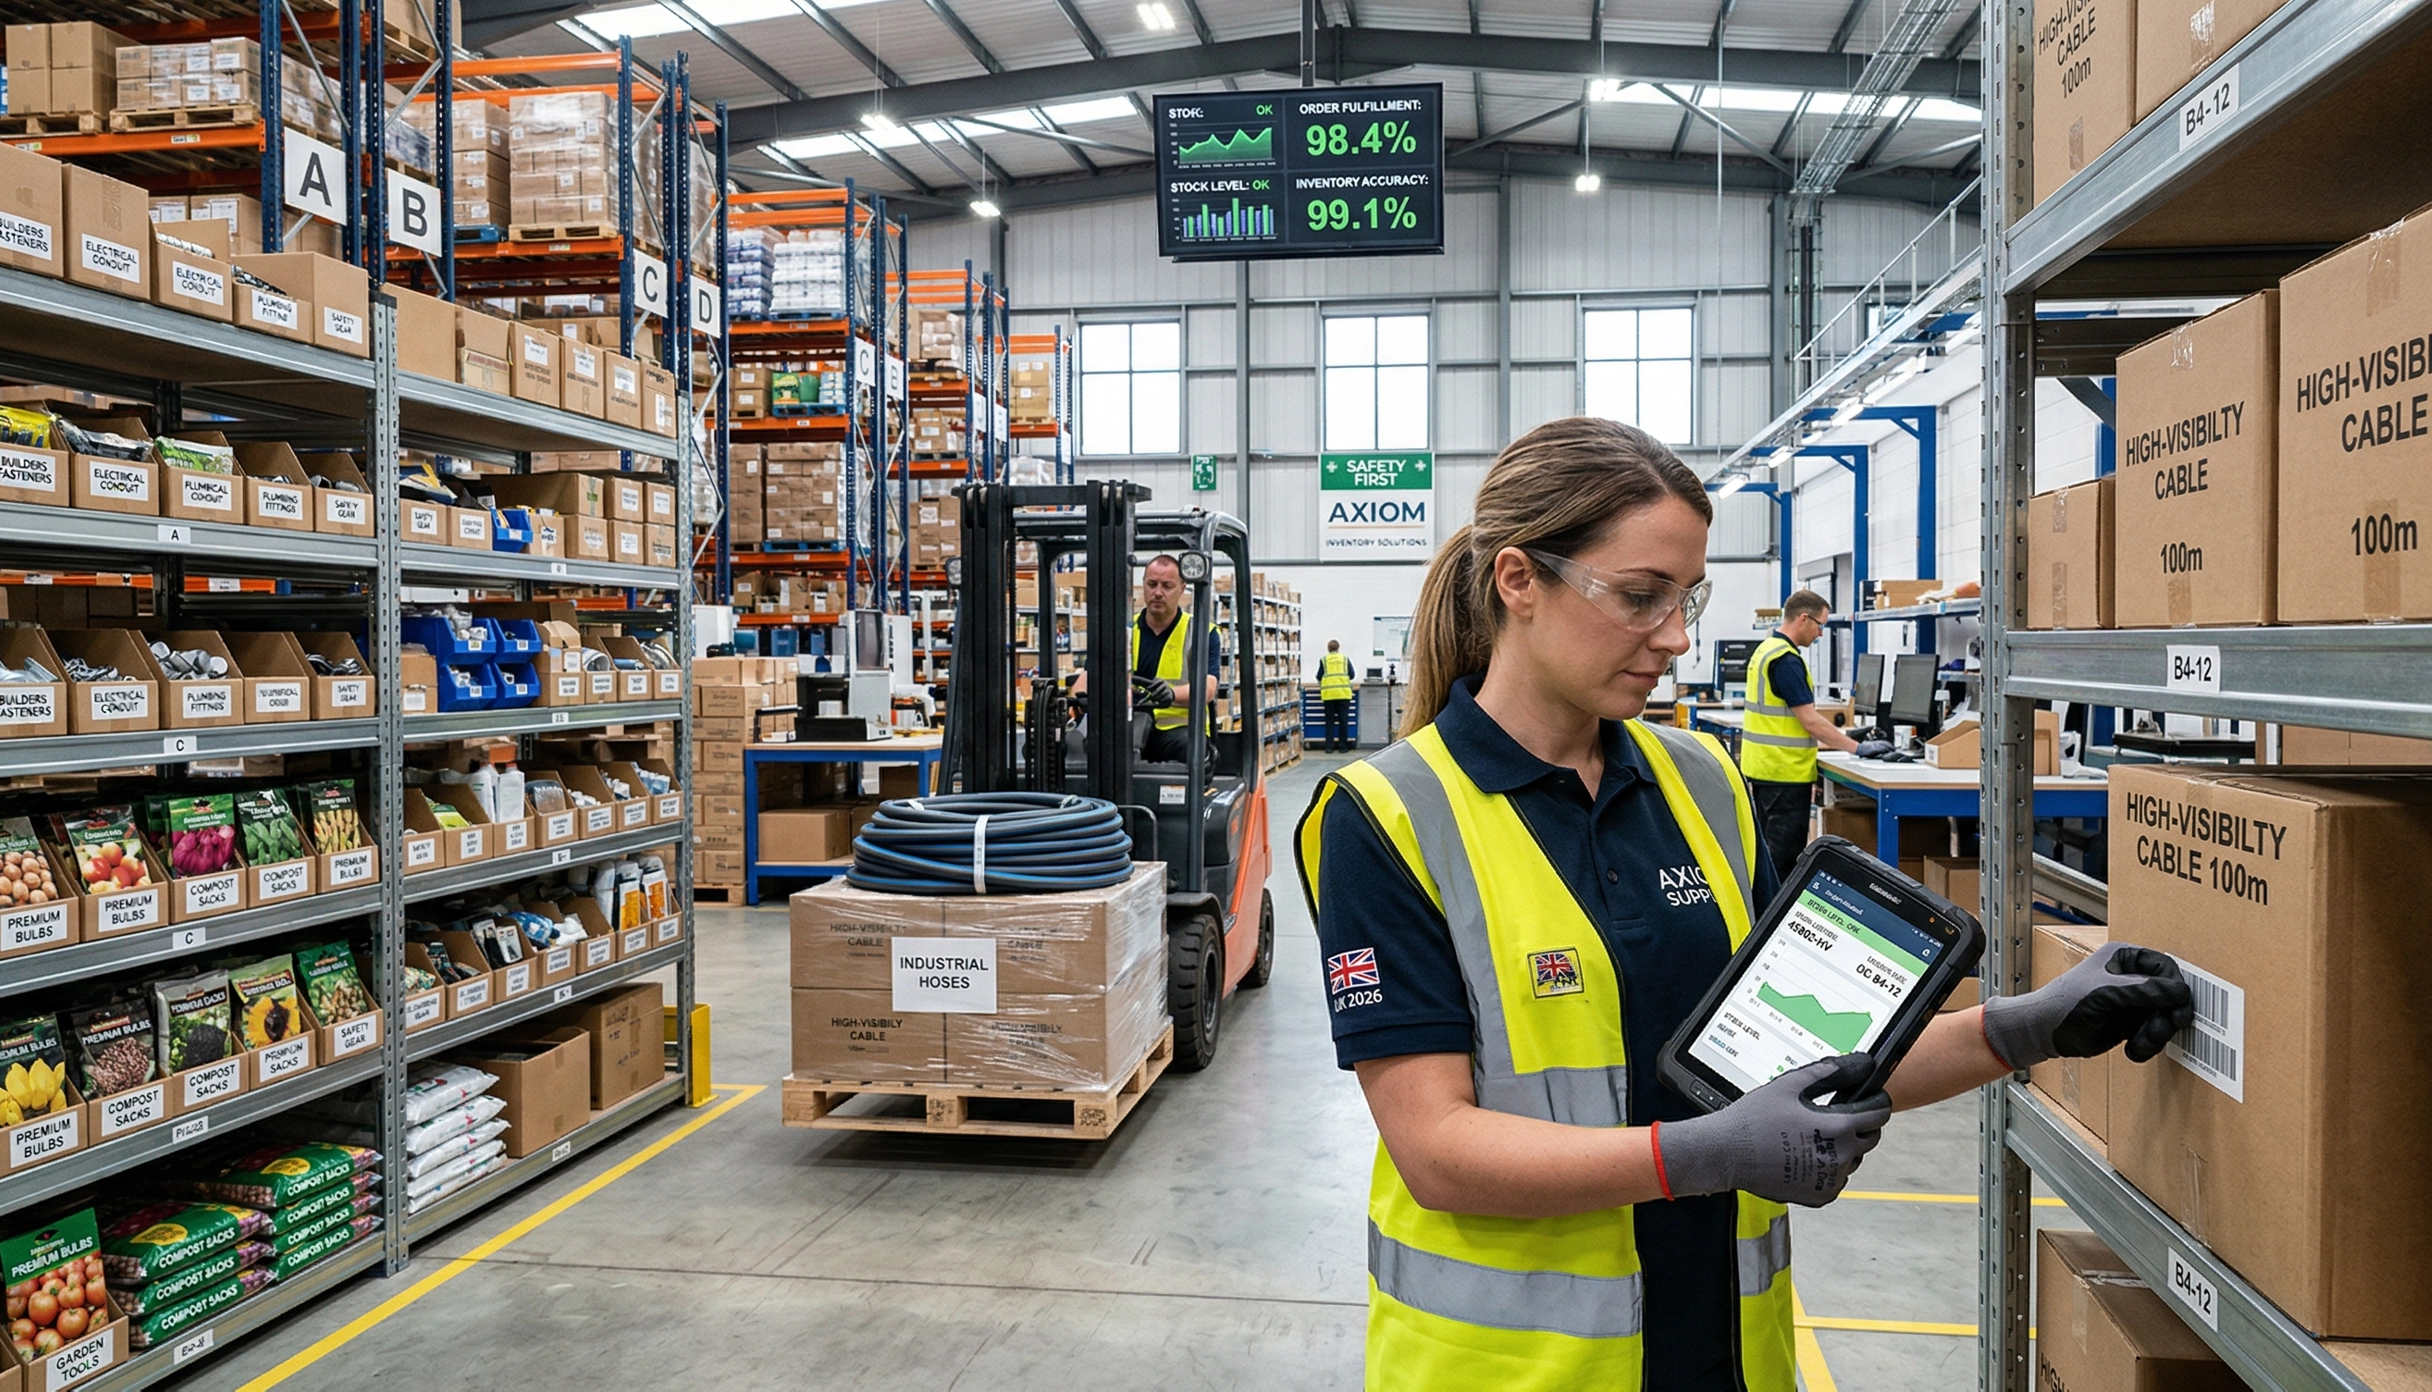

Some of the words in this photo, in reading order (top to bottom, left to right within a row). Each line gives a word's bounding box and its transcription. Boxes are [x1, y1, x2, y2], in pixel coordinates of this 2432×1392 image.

[2057, 6, 2096, 66] CABLE
[2061, 57, 2092, 99] 100m
[1256, 104, 1273, 116] OK
[1299, 101, 1340, 115] ORDER
[1342, 99, 1422, 113] FULFILLMENT:
[2186, 82, 2230, 137] B4-12
[1306, 120, 1417, 156] 98.4%
[299, 151, 332, 207] A
[1170, 180, 1209, 193] STOCK
[1211, 179, 1249, 192] LEVEL:
[1252, 179, 1270, 191] OK
[1296, 175, 1360, 189] INVENTORY
[1362, 174, 1429, 187] ACCURACY:
[402, 187, 428, 237] B
[1307, 196, 1417, 231] 99.1%
[642, 264, 658, 303] C
[698, 288, 712, 324] D
[860, 349, 869, 376] C
[2126, 400, 2244, 467] HIGH-VISIBILTY
[2341, 393, 2428, 452] CABLE
[1346, 459, 1407, 473] SAFETY
[1354, 473, 1398, 486] FIRST
[2154, 458, 2208, 500] CABLE
[1328, 501, 1426, 523] AXIOM
[171, 529, 179, 541] A
[1325, 538, 1375, 547] INVENTORY
[1378, 538, 1427, 547] SOLUTIONS
[2351, 513, 2418, 556] 100m
[2160, 541, 2203, 574] 100m
[2174, 655, 2212, 682] B4-12
[176, 740, 185, 752] C
[2126, 791, 2287, 860] HIGH-VISIBILTY
[2136, 835, 2202, 884] CABLE
[2209, 857, 2268, 906] 100m
[190, 878, 235, 895] COMPOST
[105, 895, 152, 912] PREMIUM
[8, 910, 60, 930] PREMIUM
[112, 909, 145, 924] BULBS
[15, 925, 53, 943] BULBS
[185, 932, 193, 944] C
[900, 957, 988, 971] INDUSTRIAL
[919, 976, 970, 989] HOSES
[1871, 973, 1902, 998] B4-12
[1333, 995, 1348, 1013] UK
[1347, 988, 1383, 1008] 2026
[345, 1034, 366, 1048] GEAR
[850, 1031, 886, 1041] CABLE
[189, 1064, 236, 1087] COMPOST
[108, 1090, 159, 1114] COMPOST
[115, 1107, 151, 1127] SACKS
[16, 1118, 71, 1146] PREMIUM
[24, 1136, 64, 1158] BULBS
[11, 1249, 59, 1278] PREMIUM
[61, 1236, 94, 1258] BULBS
[2174, 1260, 2212, 1316] B4-12
[56, 1337, 104, 1370] GARDEN
[62, 1355, 100, 1381] TOOLS
